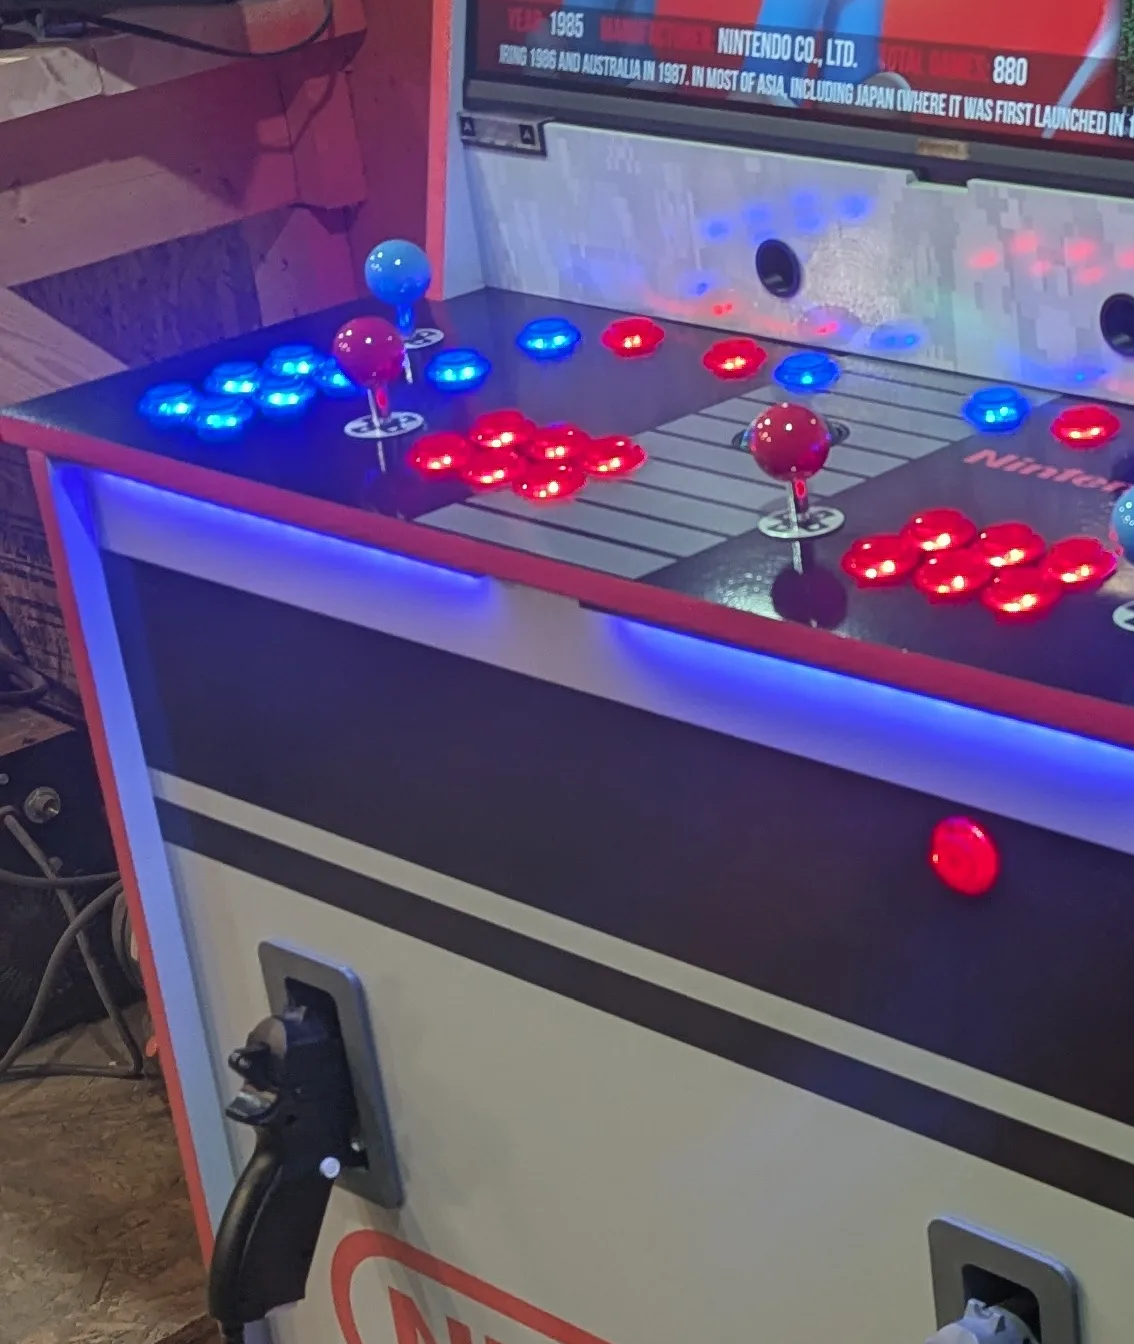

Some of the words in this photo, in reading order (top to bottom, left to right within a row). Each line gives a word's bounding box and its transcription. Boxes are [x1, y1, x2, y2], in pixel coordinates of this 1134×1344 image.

[550, 10, 584, 39] 1985
[717, 27, 792, 61] NINTENDO
[794, 34, 823, 68] CO.,
[826, 37, 858, 68] LTD.
[993, 55, 1028, 87] 880
[530, 47, 557, 70] 1986
[558, 50, 581, 74] AND
[582, 53, 640, 81] AUSTRALIA
[643, 59, 656, 82] IN
[659, 62, 690, 87] 1987.
[691, 64, 705, 87] IN
[706, 66, 739, 92] MOST
[740, 71, 755, 93] OF
[756, 74, 788, 100] ASIA,
[790, 76, 854, 105] INCLUDING
[855, 83, 895, 111] JAPAN
[897, 88, 947, 117] (WHERE
[948, 94, 963, 118] IT
[964, 96, 993, 122] WAS
[995, 99, 1034, 127] FIRST
[1034, 103, 1106, 135] LAUNCHED
[1108, 110, 1126, 138] IN
